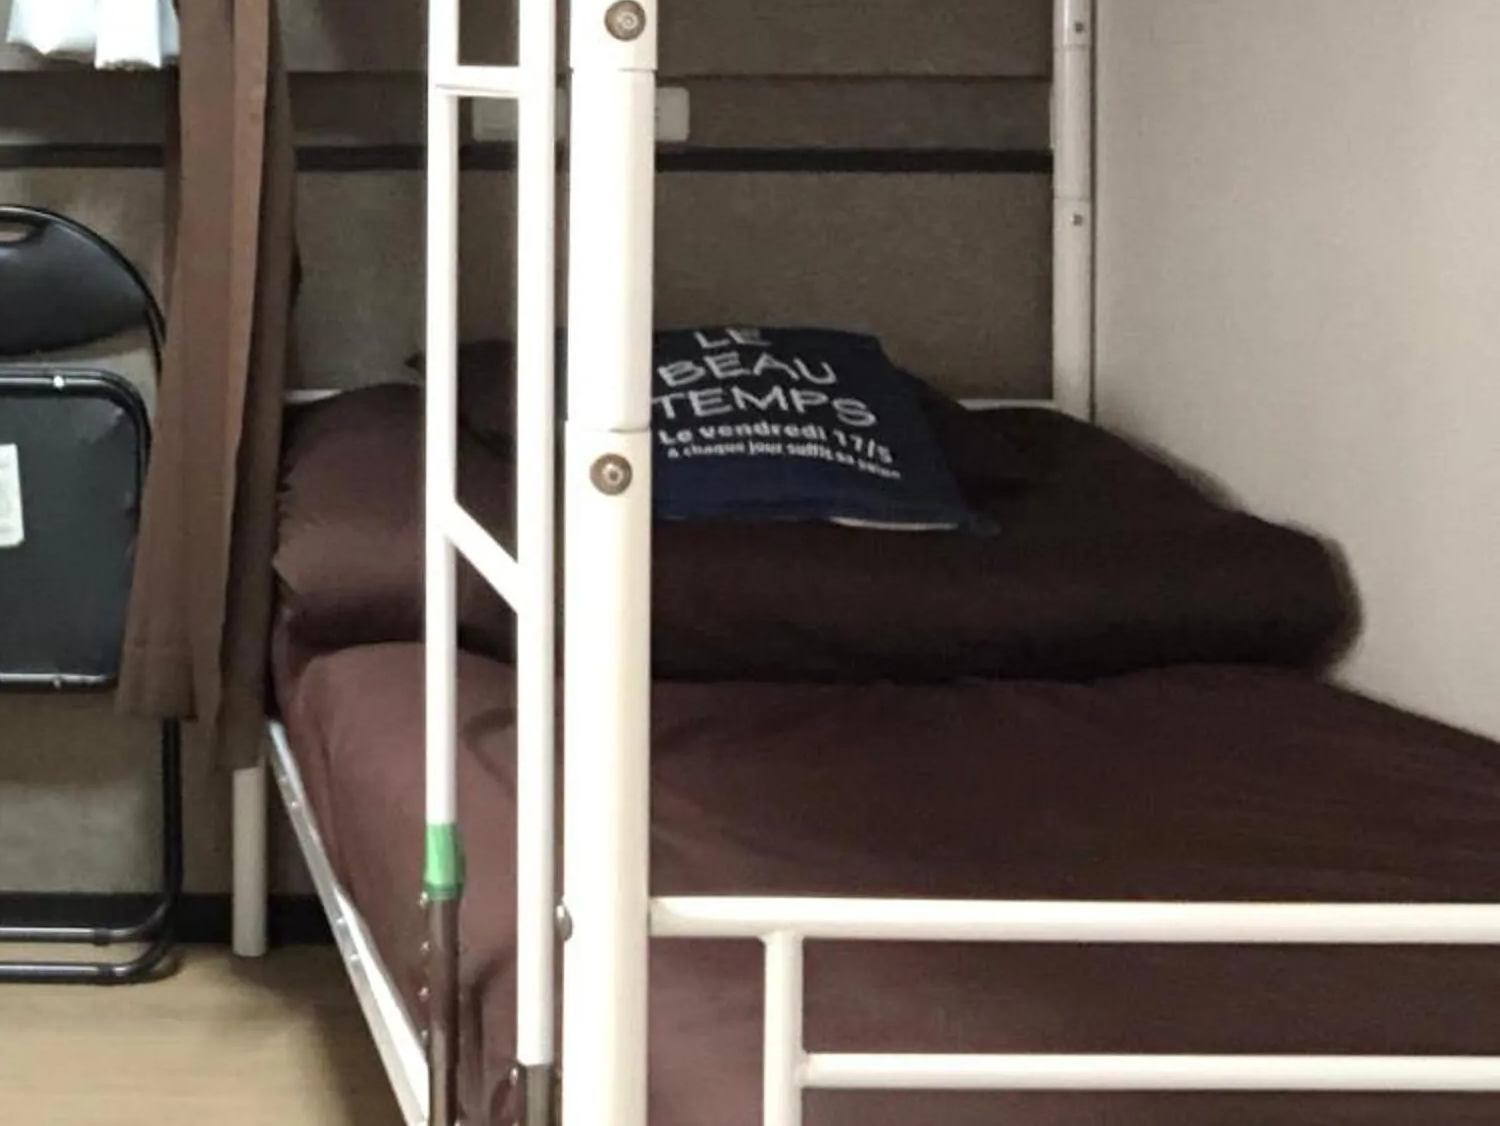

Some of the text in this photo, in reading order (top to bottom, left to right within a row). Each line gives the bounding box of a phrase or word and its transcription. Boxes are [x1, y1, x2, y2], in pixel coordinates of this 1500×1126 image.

[695, 328, 771, 348] LE
[657, 351, 838, 387] BEAU
[653, 385, 878, 428] TEMPS
[658, 421, 892, 464] Le vendredi 17/5
[748, 440, 783, 455] jour
